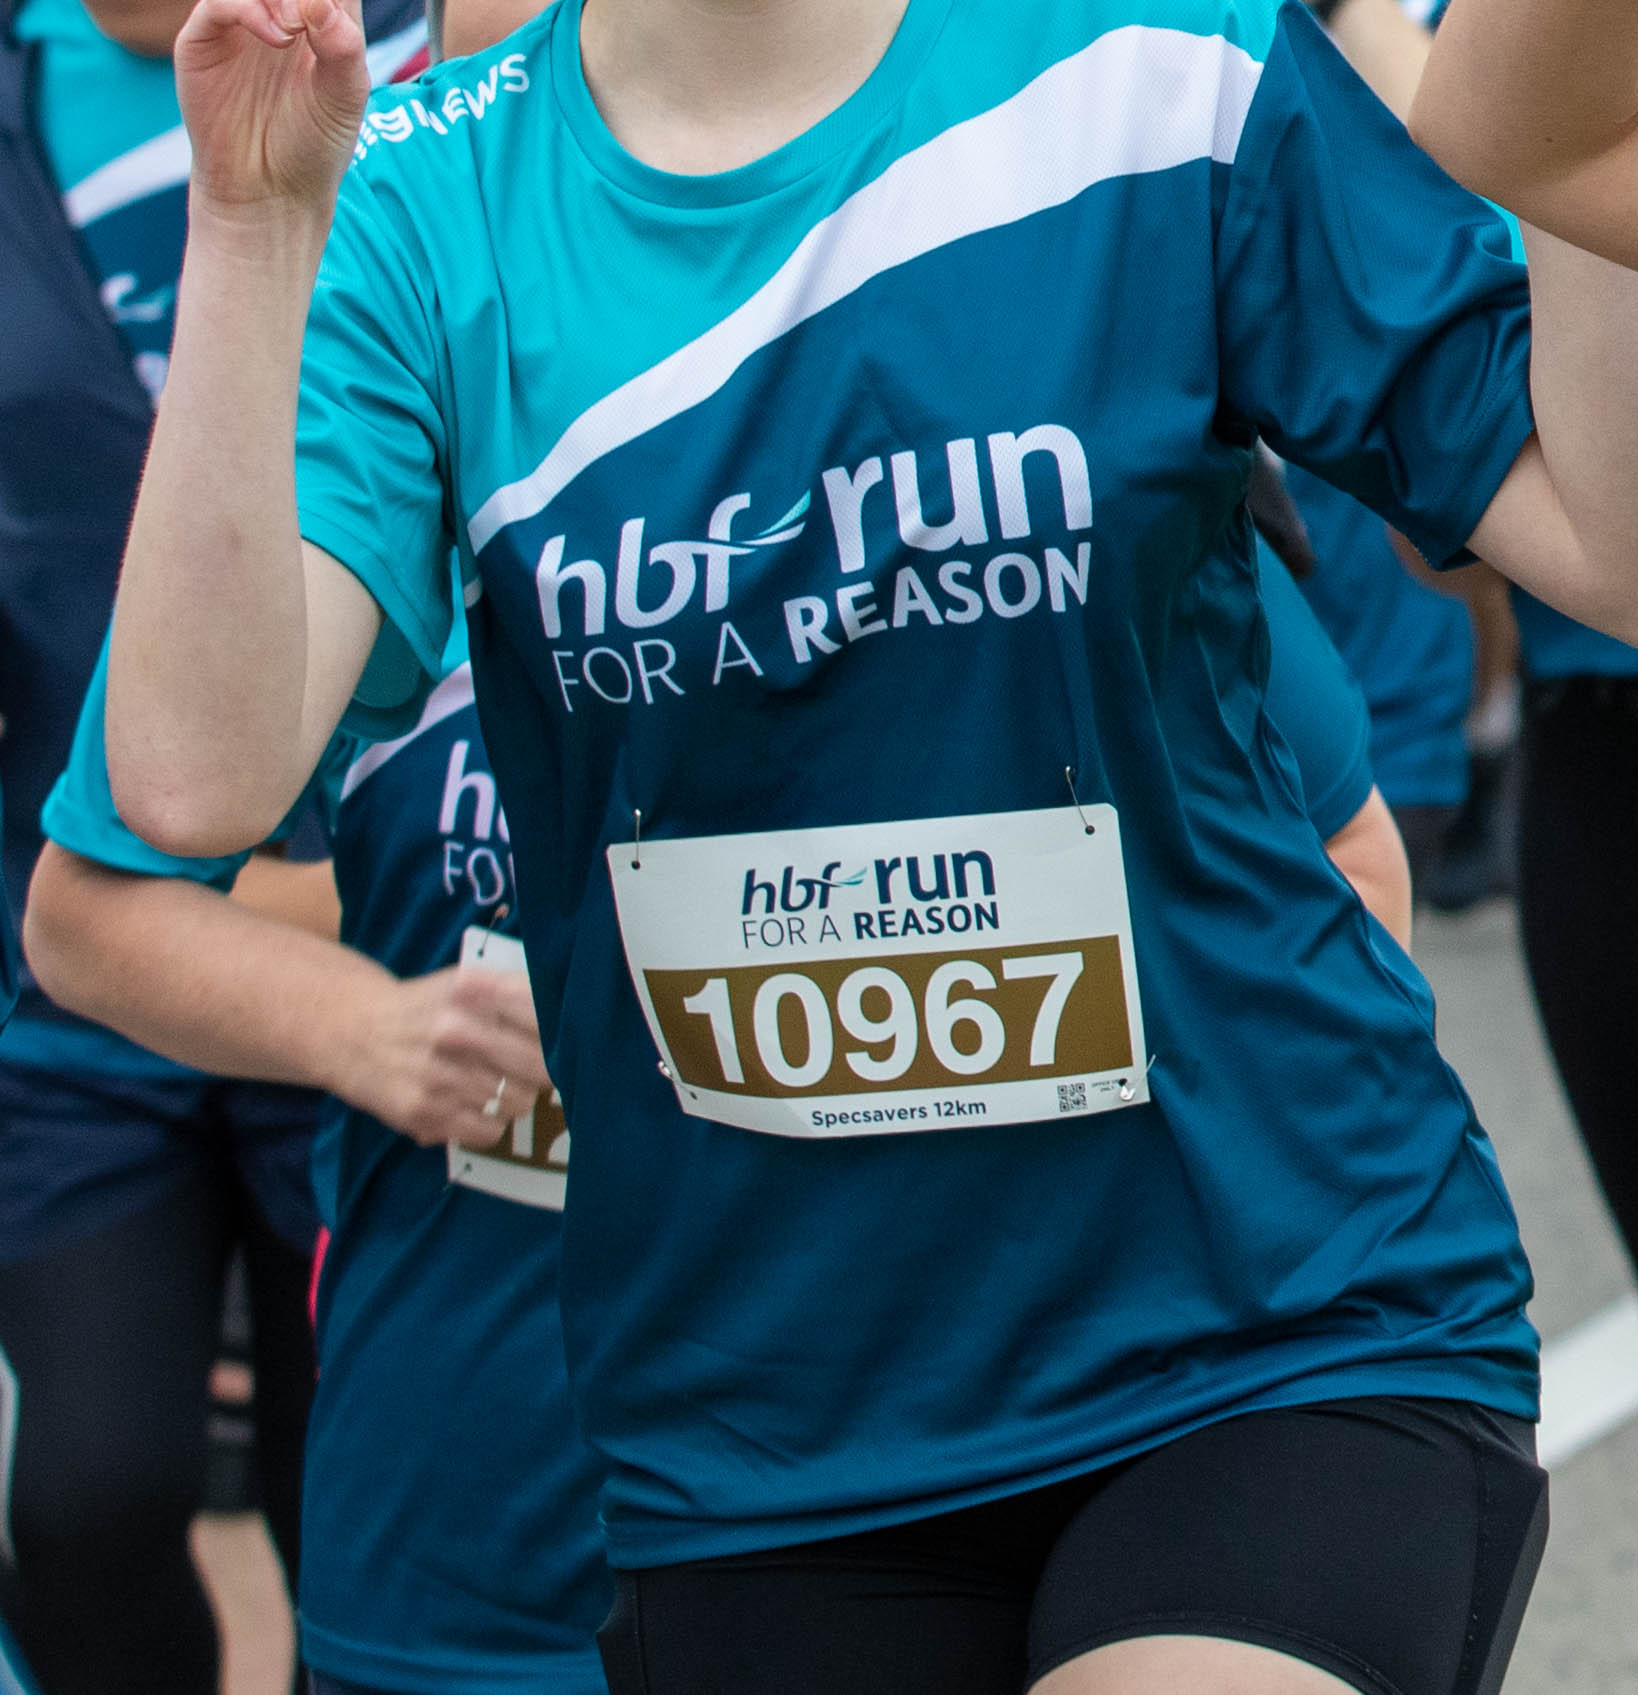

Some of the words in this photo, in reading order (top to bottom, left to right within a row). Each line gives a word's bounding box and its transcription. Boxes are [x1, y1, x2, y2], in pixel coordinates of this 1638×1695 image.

[536, 492, 765, 640] hbf
[822, 423, 1094, 575] run
[552, 638, 686, 714] FOR
[713, 620, 764, 686] A
[783, 541, 1093, 664] REASON
[442, 840, 517, 906] FO
[741, 860, 845, 917] hbf
[874, 849, 997, 906] run
[741, 916, 808, 950] FOR
[819, 913, 843, 944] A
[852, 901, 1001, 941] REASON
[683, 950, 1086, 1089] 10967
[811, 1104, 928, 1129] Specsavers
[933, 1099, 987, 1118] 12km
